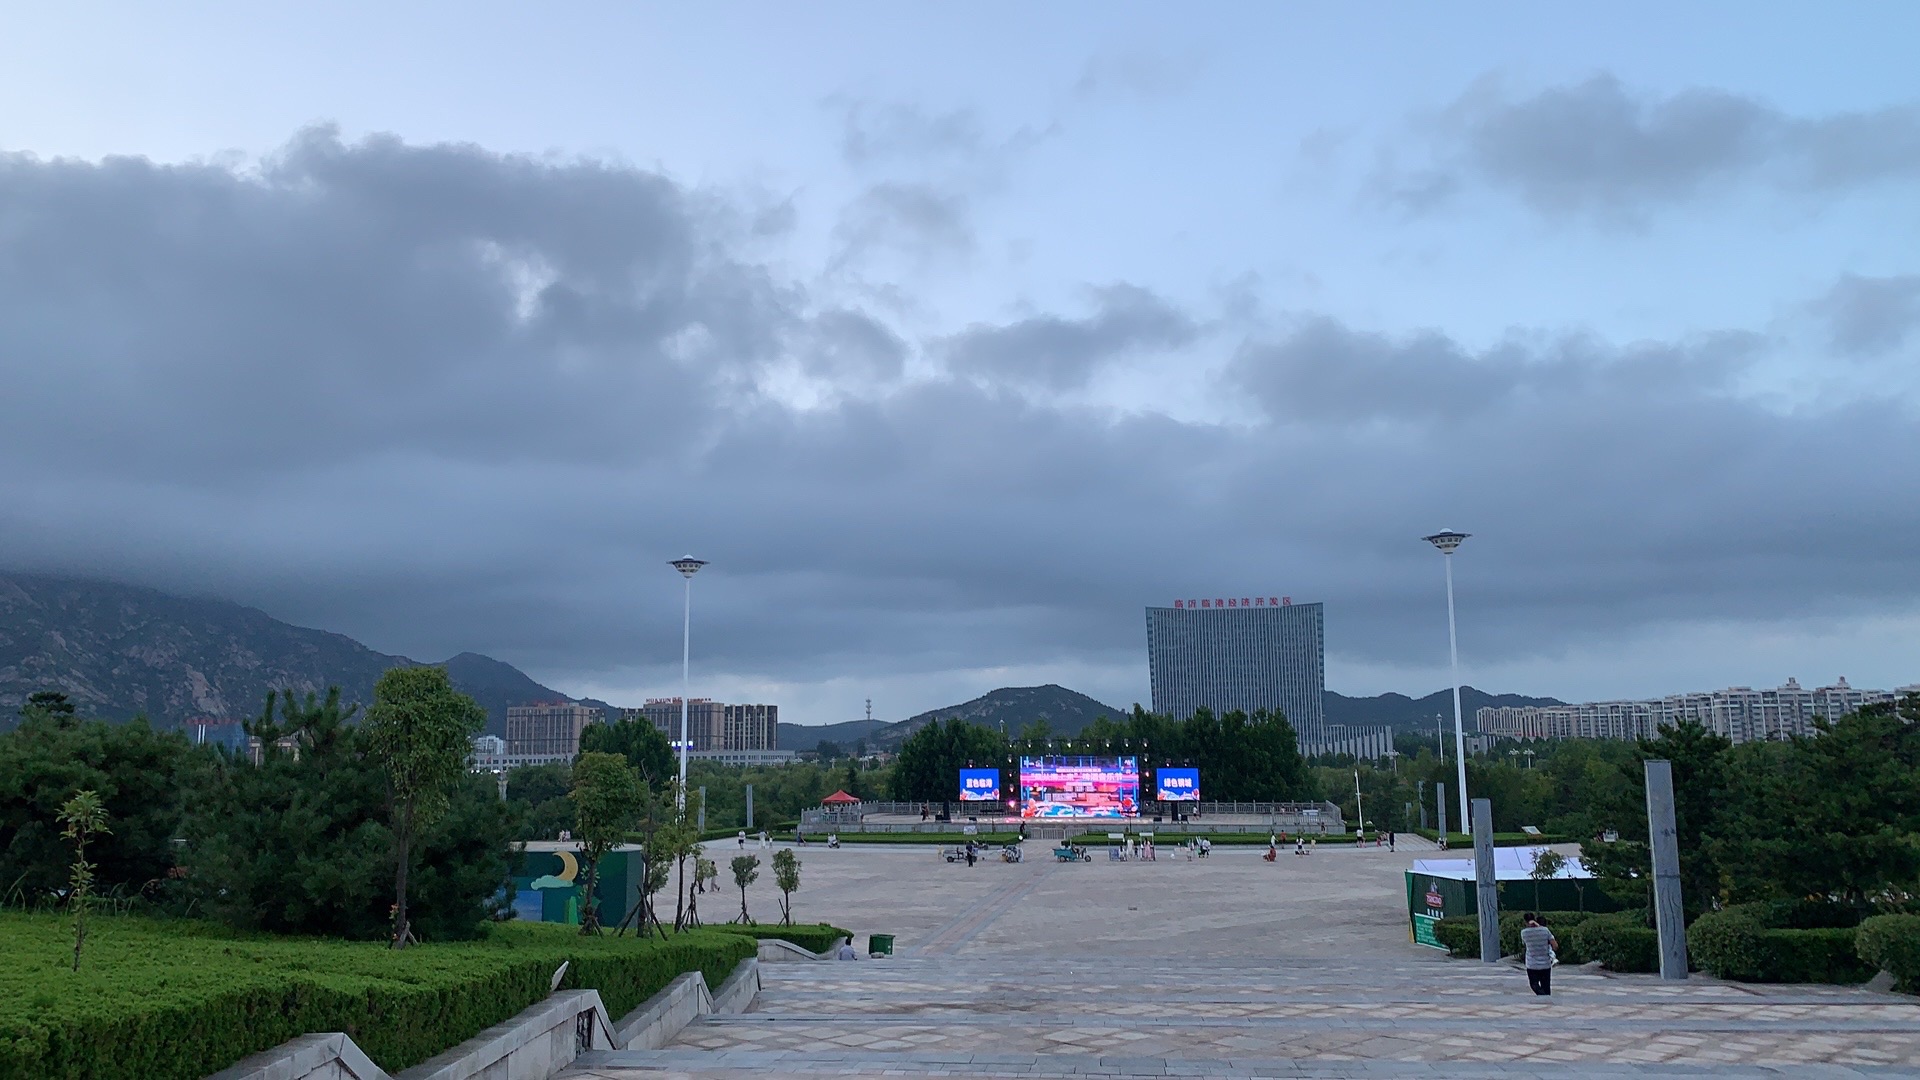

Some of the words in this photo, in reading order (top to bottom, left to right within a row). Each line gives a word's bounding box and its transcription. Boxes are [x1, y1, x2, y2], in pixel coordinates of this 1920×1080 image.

[1174, 597, 1291, 609] 临沂临港经济开发区
